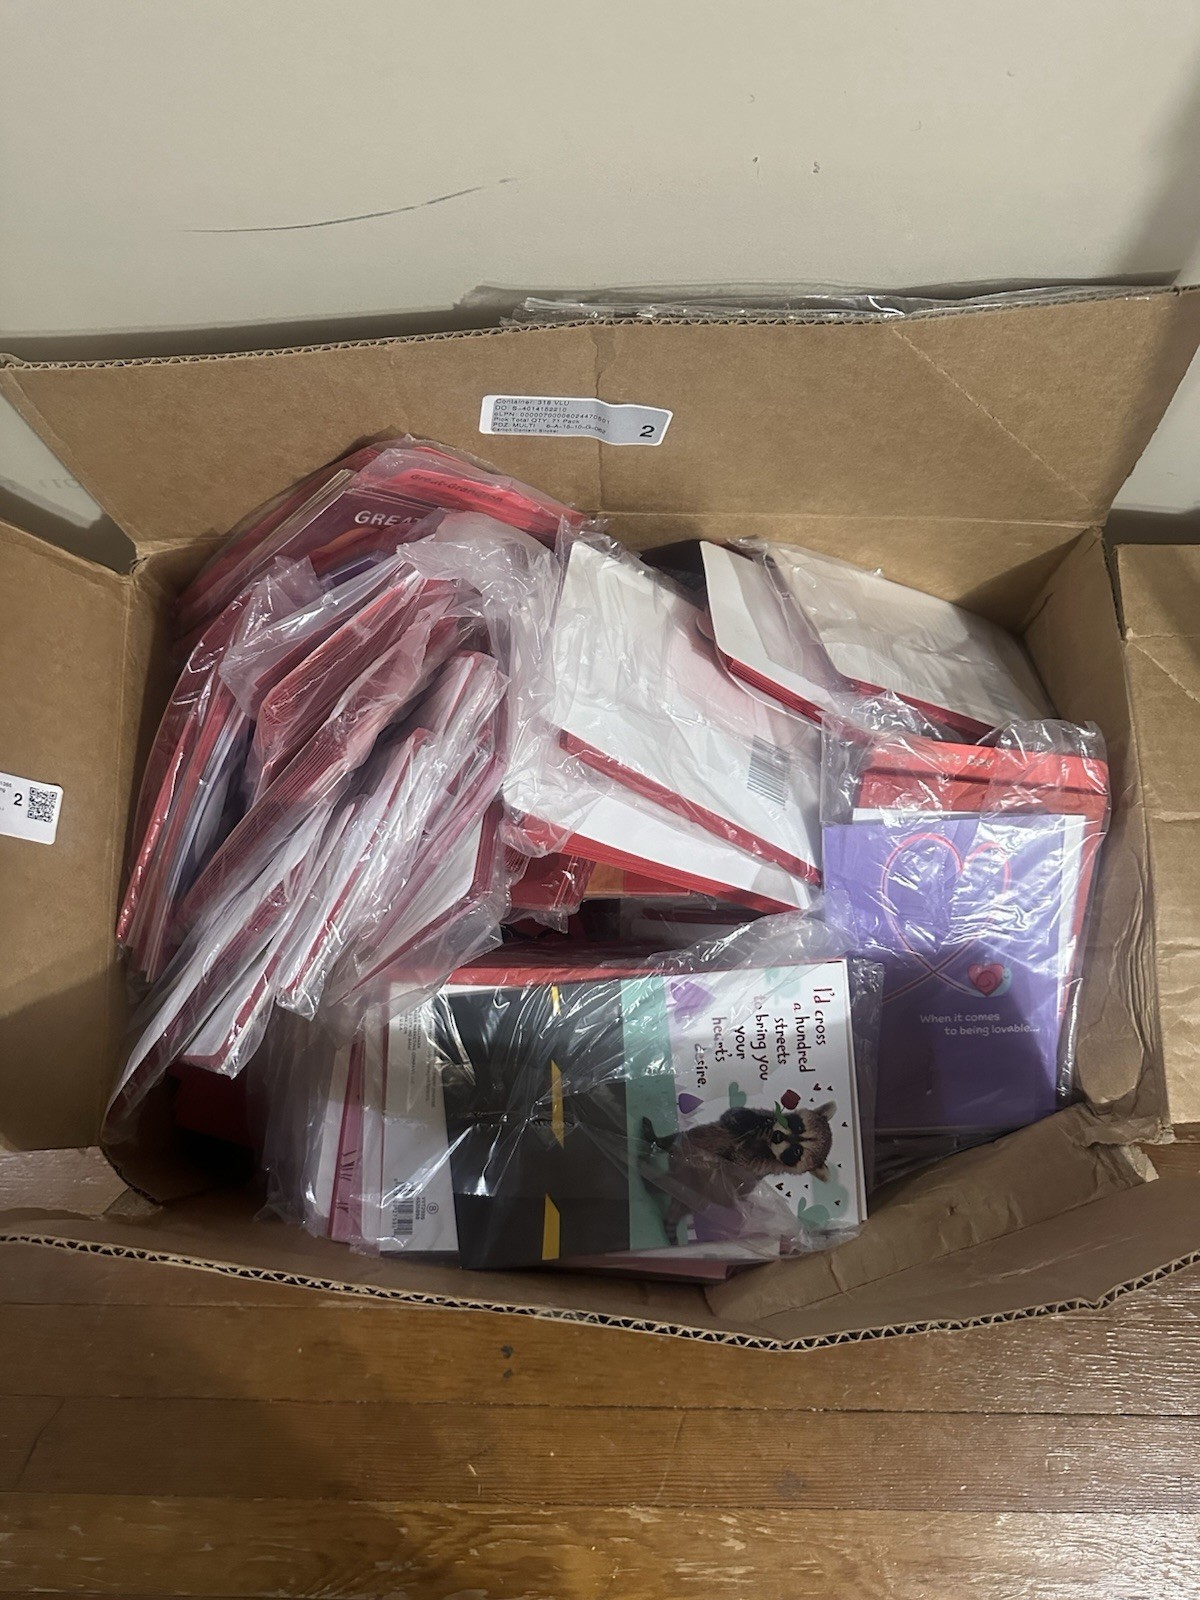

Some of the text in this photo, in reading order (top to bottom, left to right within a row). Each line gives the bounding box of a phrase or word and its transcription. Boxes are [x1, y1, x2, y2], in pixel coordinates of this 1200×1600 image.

[640, 425, 655, 438] 2
[14, 793, 22, 806] 2
[813, 987, 835, 1046] I'd cross
[920, 1013, 1000, 1023] When it comes
[944, 1026, 956, 1035] to
[960, 1026, 989, 1036] being
[712, 1017, 732, 1062] heart's
[734, 1026, 746, 1059] your
[750, 996, 769, 1080] to bring you
[774, 1018, 790, 1065] streets
[793, 1003, 816, 1072] a hundred
